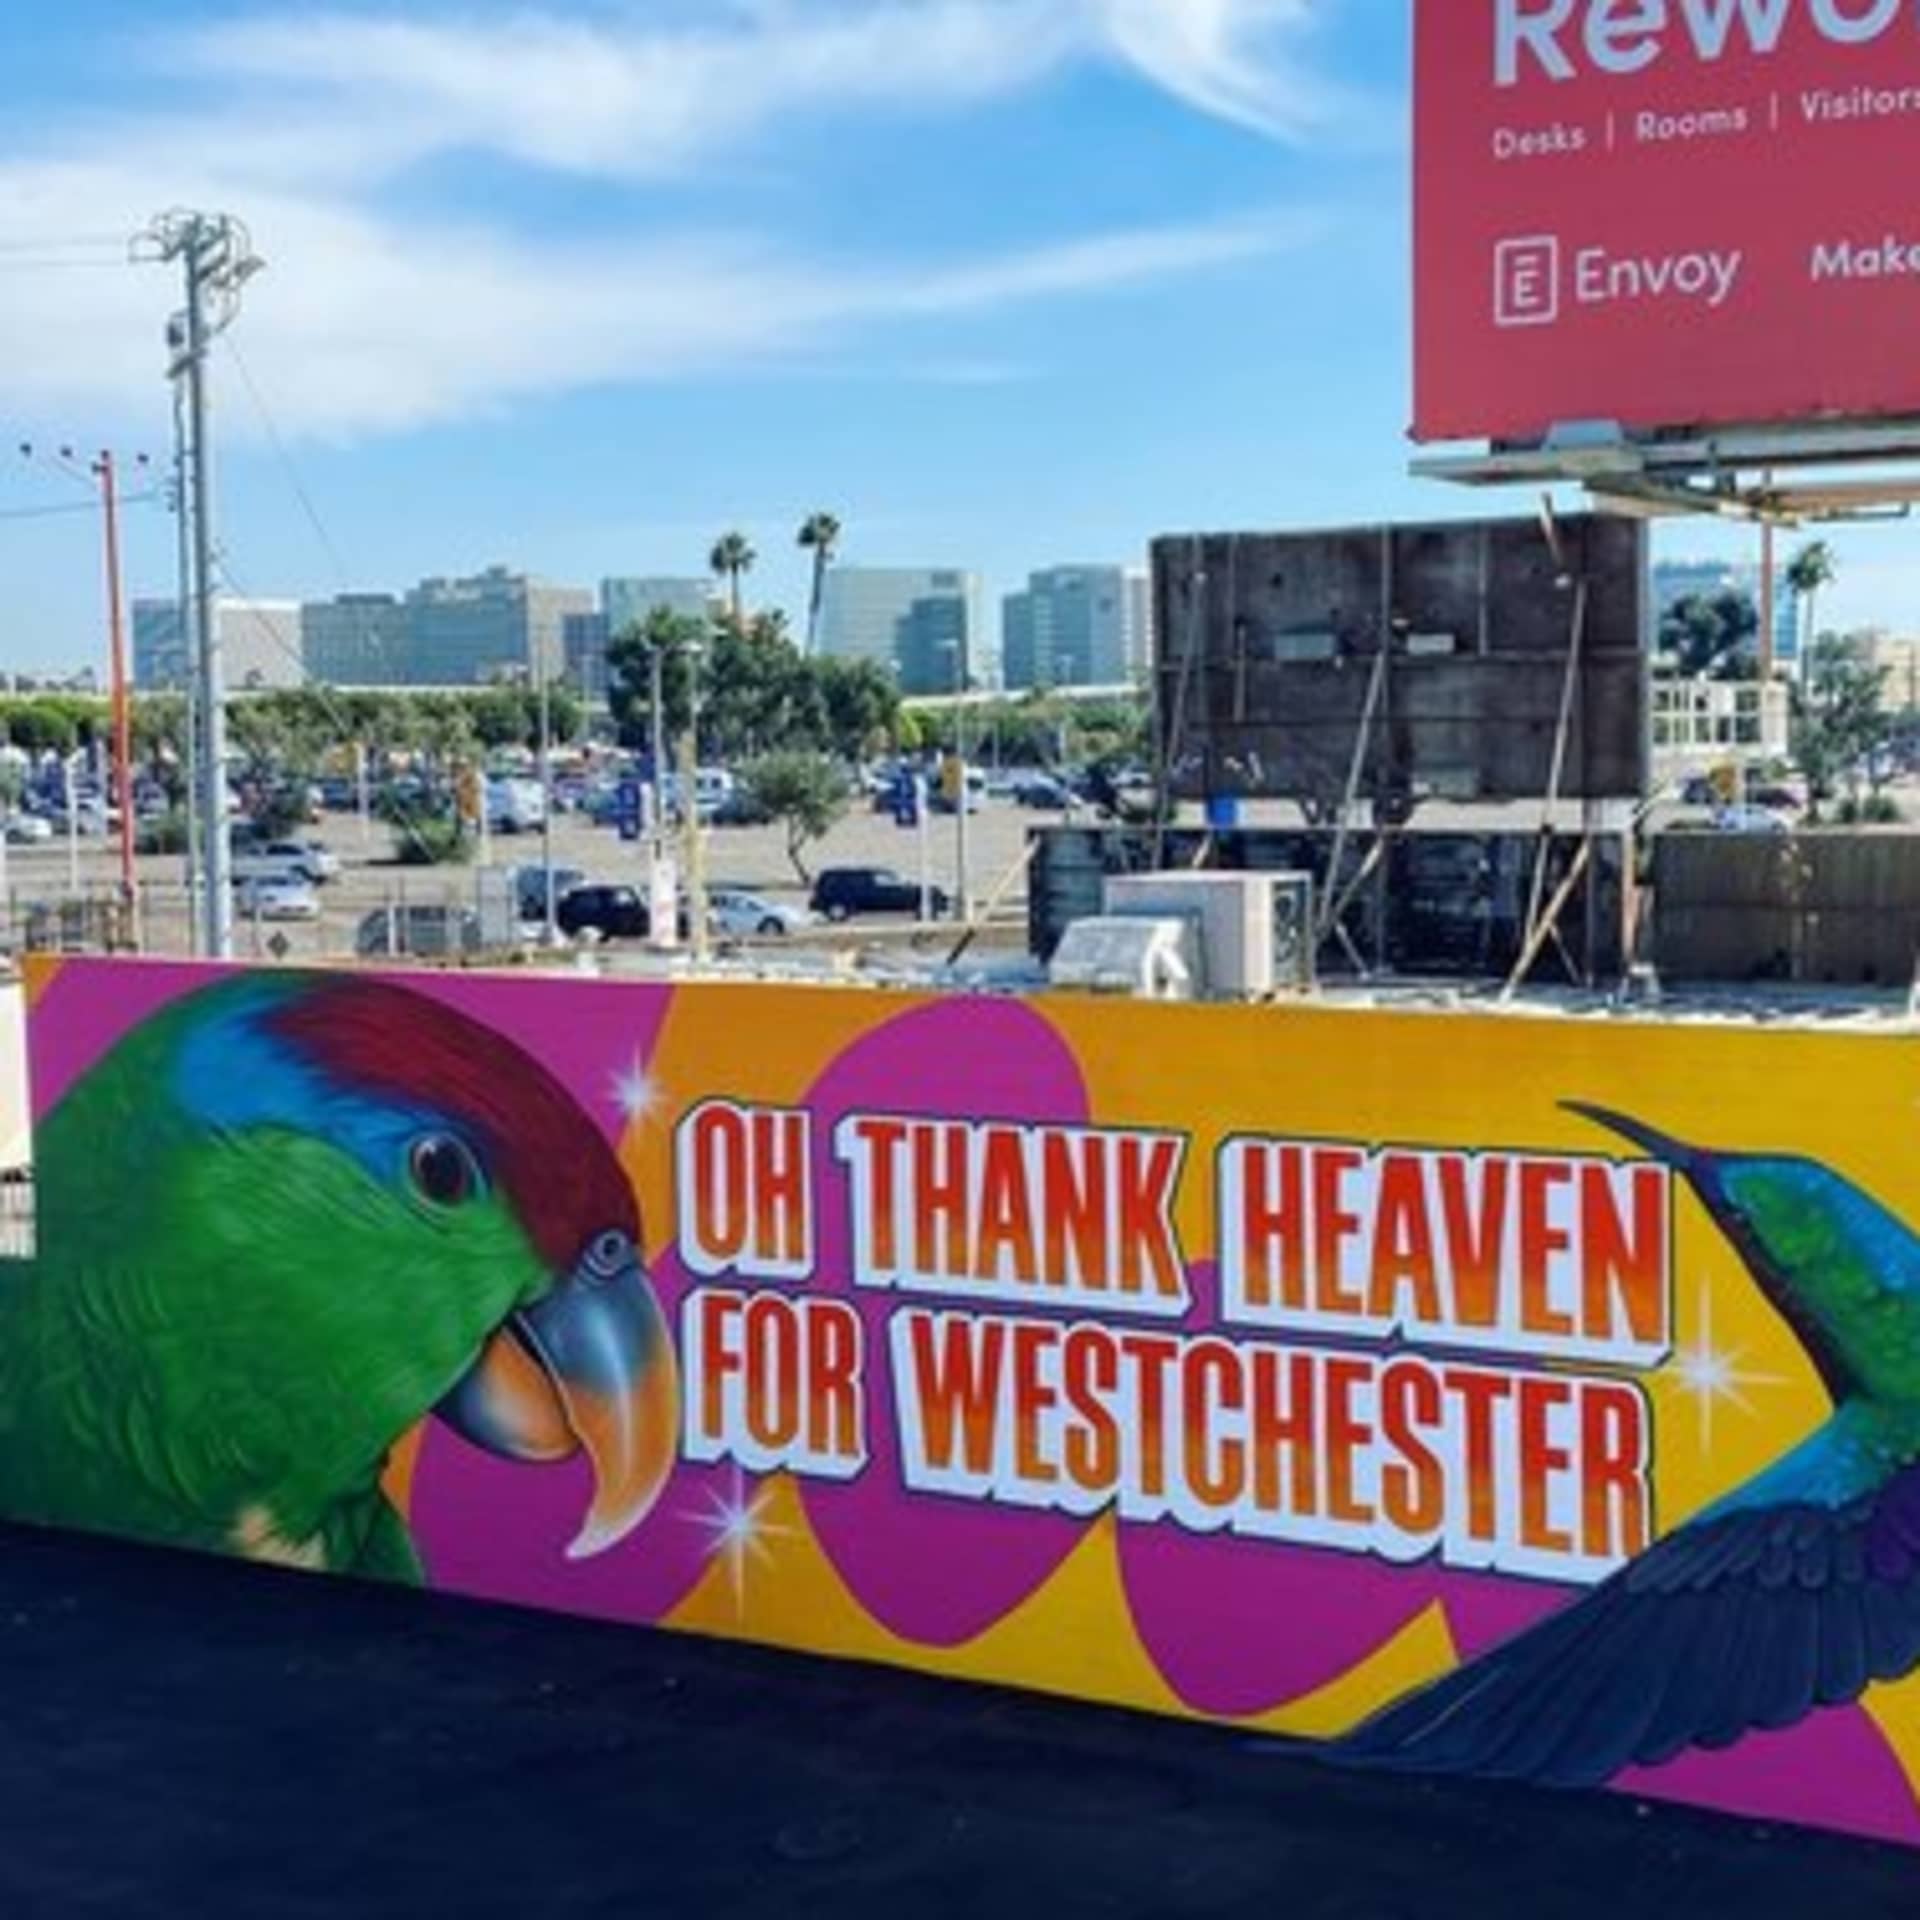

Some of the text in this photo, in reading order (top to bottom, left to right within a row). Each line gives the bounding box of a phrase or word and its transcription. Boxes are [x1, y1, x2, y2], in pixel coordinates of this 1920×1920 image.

[1493, 0, 1920, 85] Rewo
[1491, 122, 1587, 159] Desks
[1636, 107, 1748, 141] Rooms
[1575, 247, 1742, 307] Envoy
[691, 1102, 1666, 1347] OH THANK HEAVEN
[698, 1291, 1647, 1562] FOR WESTCHESTER
